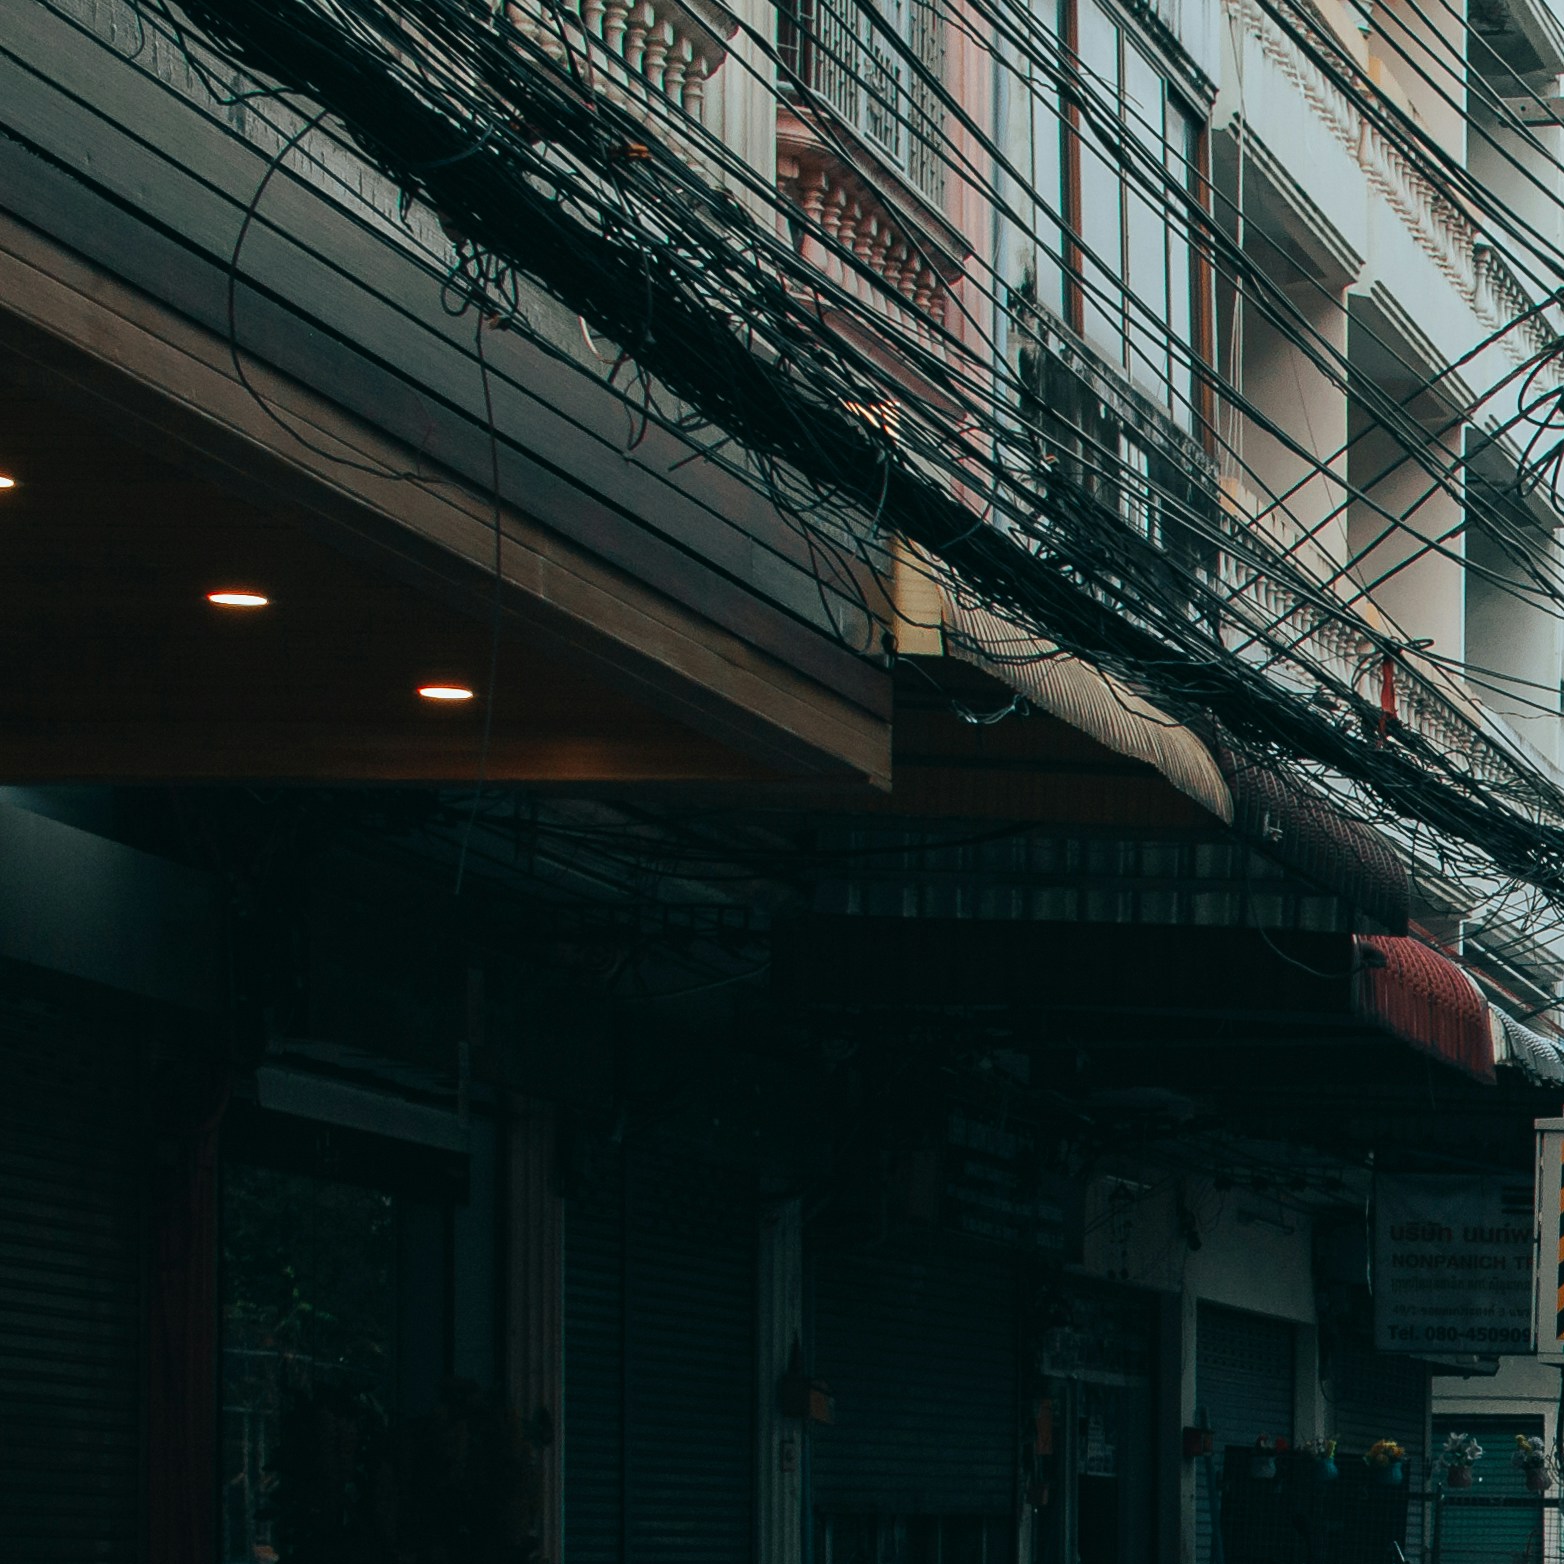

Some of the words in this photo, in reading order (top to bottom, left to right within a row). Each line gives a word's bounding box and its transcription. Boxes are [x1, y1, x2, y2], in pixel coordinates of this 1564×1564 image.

[1390, 1221, 1453, 1243] บริษัท
[1391, 1254, 1506, 1270] NONPANICH
[1387, 1324, 1419, 1341] Tel.
[1424, 1325, 1531, 1343] 080-450909
